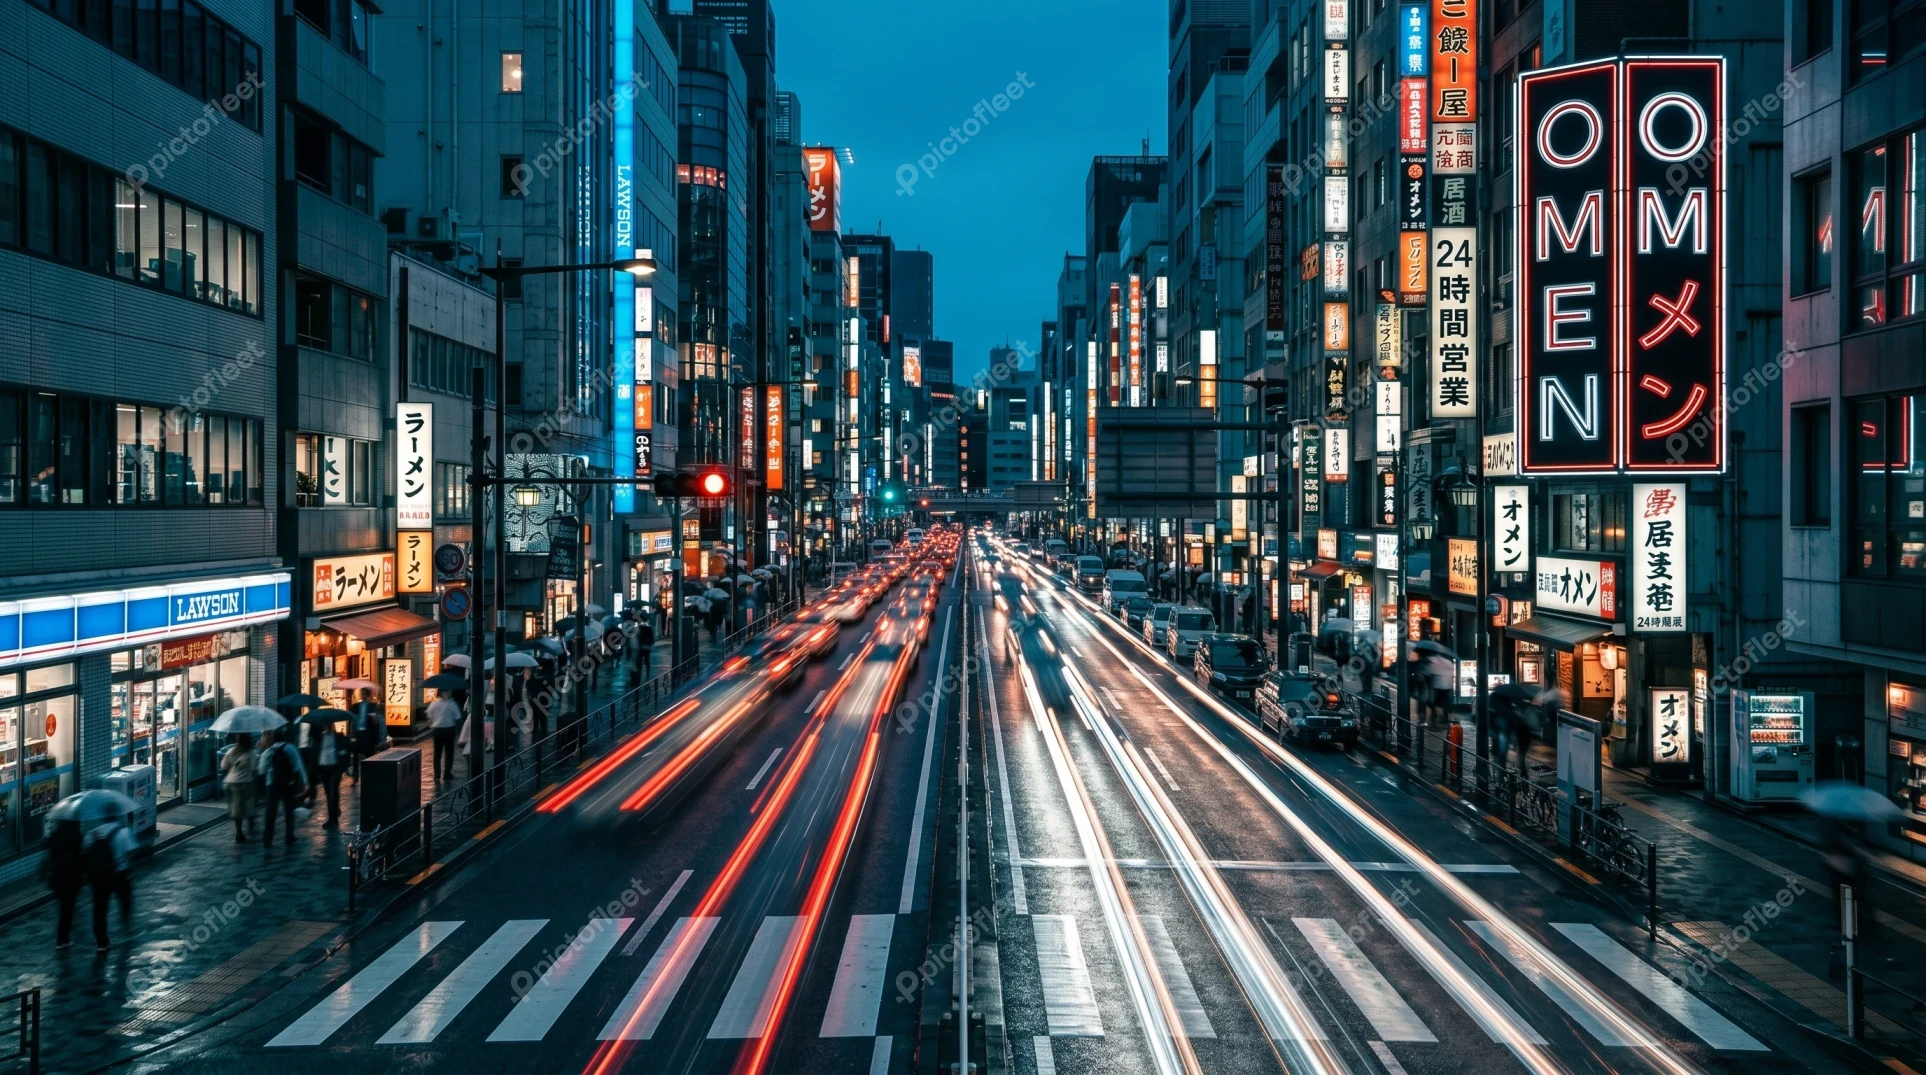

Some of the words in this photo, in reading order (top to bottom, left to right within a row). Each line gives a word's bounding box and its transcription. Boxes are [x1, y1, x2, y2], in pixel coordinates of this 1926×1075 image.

[617, 165, 631, 247] LAWSON
[809, 154, 826, 221] ラーメン
[1409, 181, 1421, 218] オメン
[1442, 177, 1466, 224] 居酒
[1436, 239, 1473, 407] 24時間営業
[404, 412, 424, 498] ラーメン
[407, 535, 421, 588] ラーメン
[1502, 499, 1522, 566] オメン
[177, 592, 240, 621] LAWSON
[336, 564, 381, 601] ラーメン
[1560, 566, 1598, 607] オメン
[1660, 694, 1679, 758] オメン
